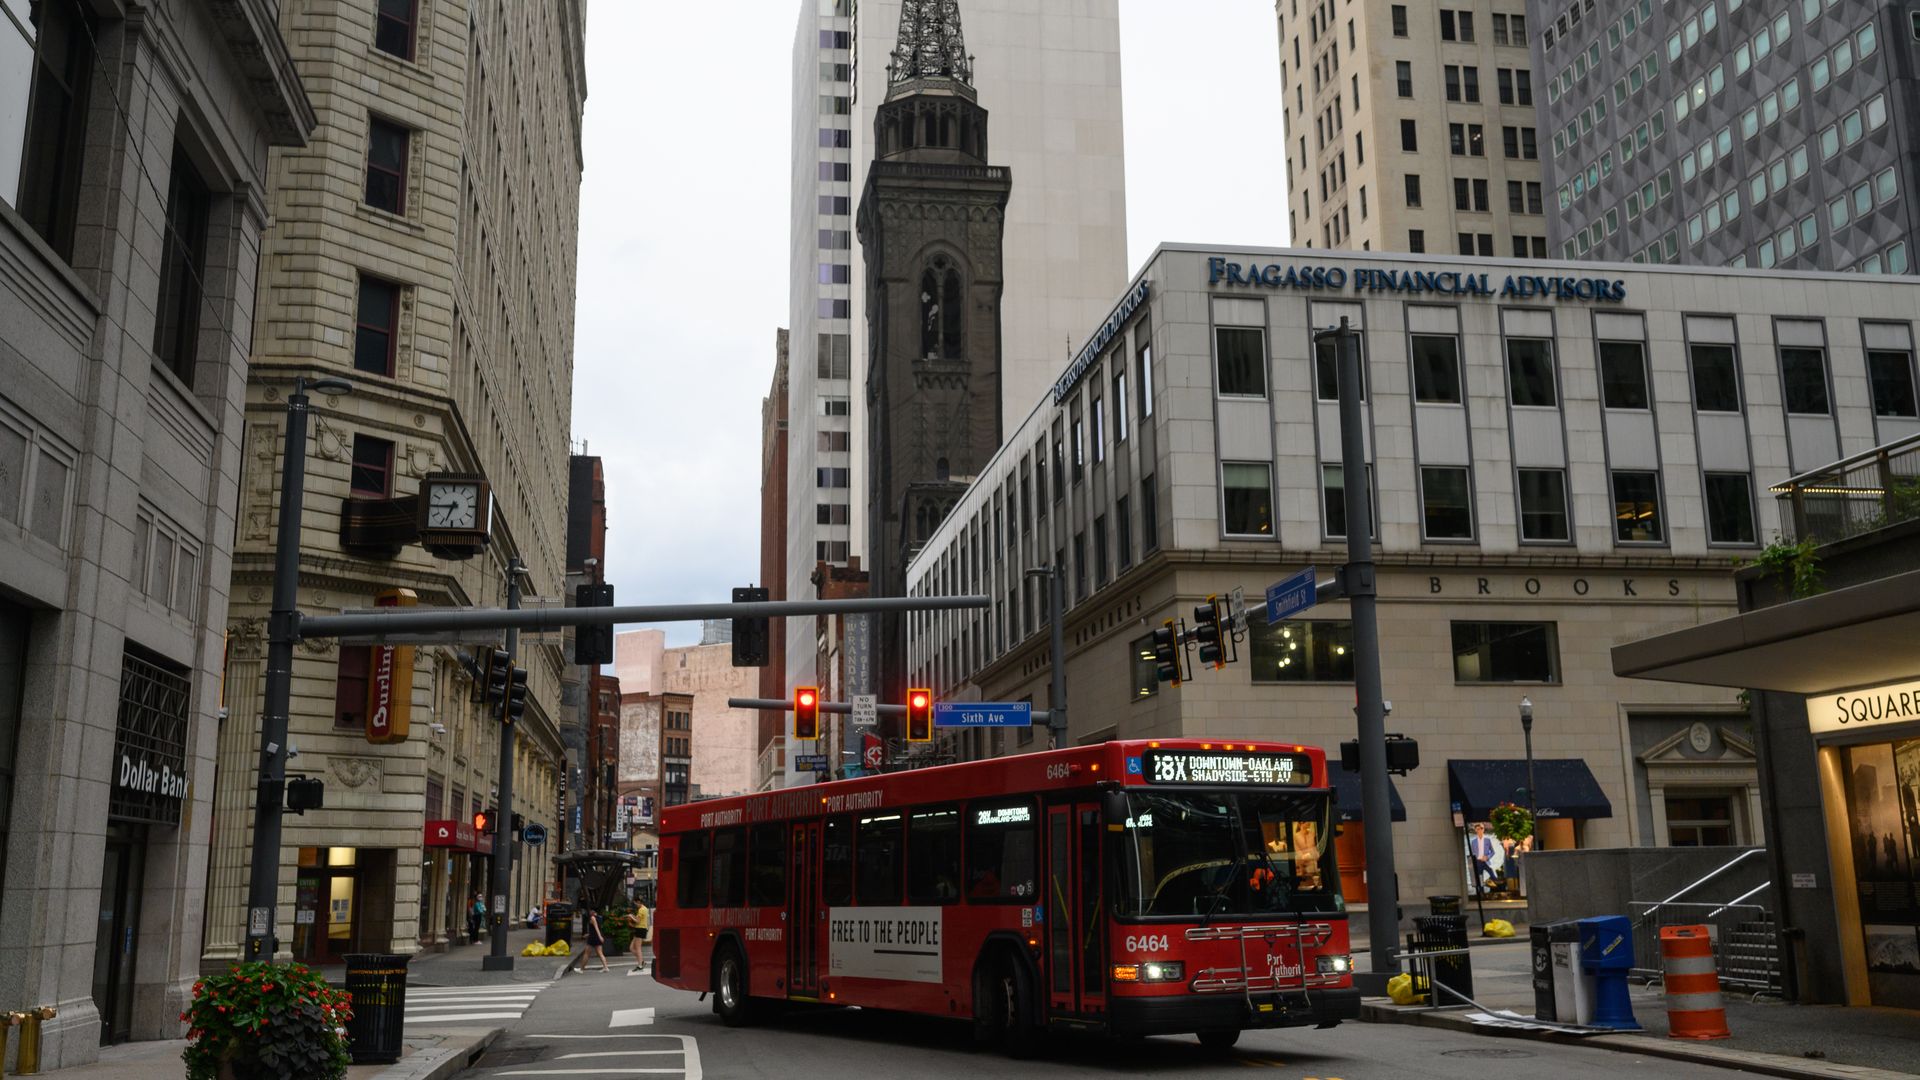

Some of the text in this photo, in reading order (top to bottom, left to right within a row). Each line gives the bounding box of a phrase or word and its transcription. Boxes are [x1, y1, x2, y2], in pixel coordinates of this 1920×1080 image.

[1208, 256, 1626, 301] FRAGASSO FINANCIAL ADVISORS
[1429, 576, 1680, 597] BROOKS
[1275, 590, 1300, 616] Smithfield
[1300, 588, 1307, 605] St
[373, 642, 396, 728] Burling
[1836, 689, 1920, 724] SQUARE
[961, 712, 1005, 724] Sixth Ave
[1047, 763, 1070, 780] 6464
[1189, 756, 1293, 772] DOWNTOWN-OAKLAND
[119, 754, 189, 800] Dollar Bank
[745, 789, 825, 823] PORT AUTHORITY
[826, 790, 884, 813] PORT AUTHORITY
[700, 808, 743, 829] PORT AUTHORITY
[745, 927, 783, 942] PORT AUTHORITY
[831, 920, 938, 945] FREE TO THE PEOPLE
[1125, 935, 1169, 952] 6464
[1266, 953, 1283, 967] Port
